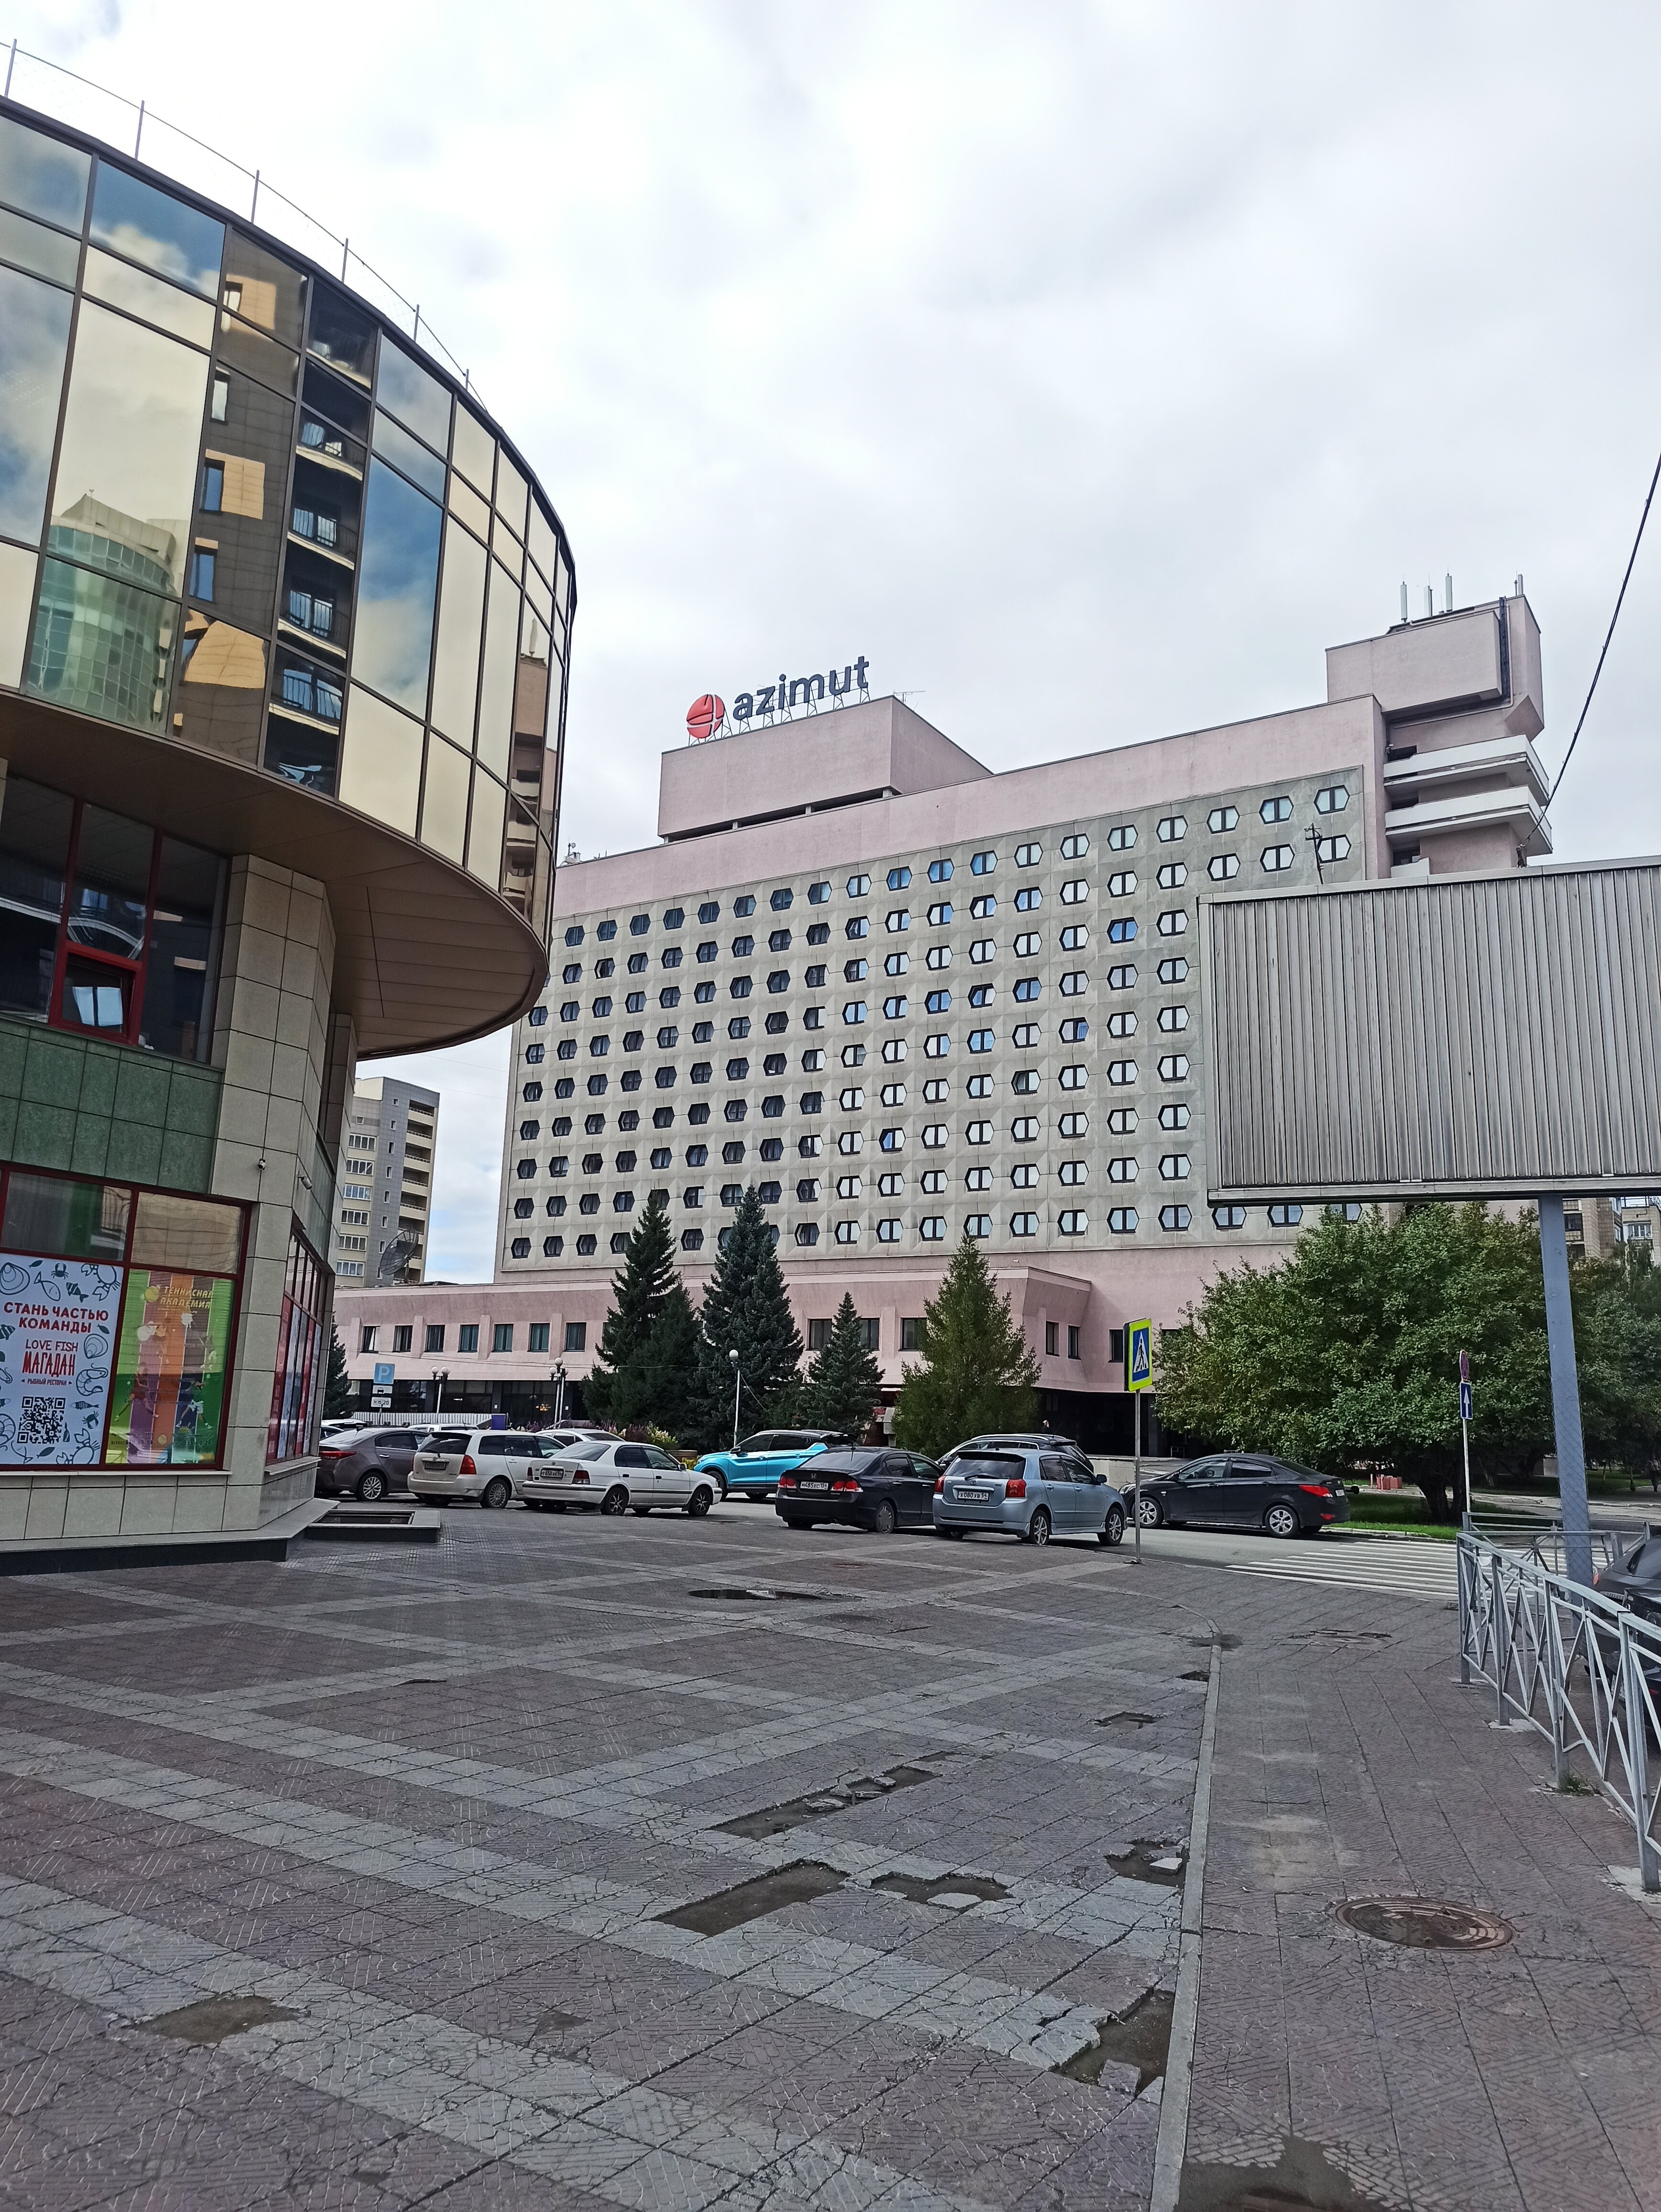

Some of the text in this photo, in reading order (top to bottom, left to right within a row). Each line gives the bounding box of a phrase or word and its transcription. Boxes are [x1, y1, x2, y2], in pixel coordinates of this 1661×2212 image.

[732, 655, 869, 720] azimut
[164, 1286, 214, 1298] ТЕННИСНАЯ
[160, 1297, 211, 1309] АКАДЕМИЯ
[4, 1302, 109, 1321] СТАНЬ ЧАСТЬЮ
[19, 1317, 91, 1334] КОМАНДЫ
[25, 1339, 78, 1352] LOVE FISH
[22, 1351, 76, 1378] МАГАДАН
[378, 1365, 390, 1381] P
